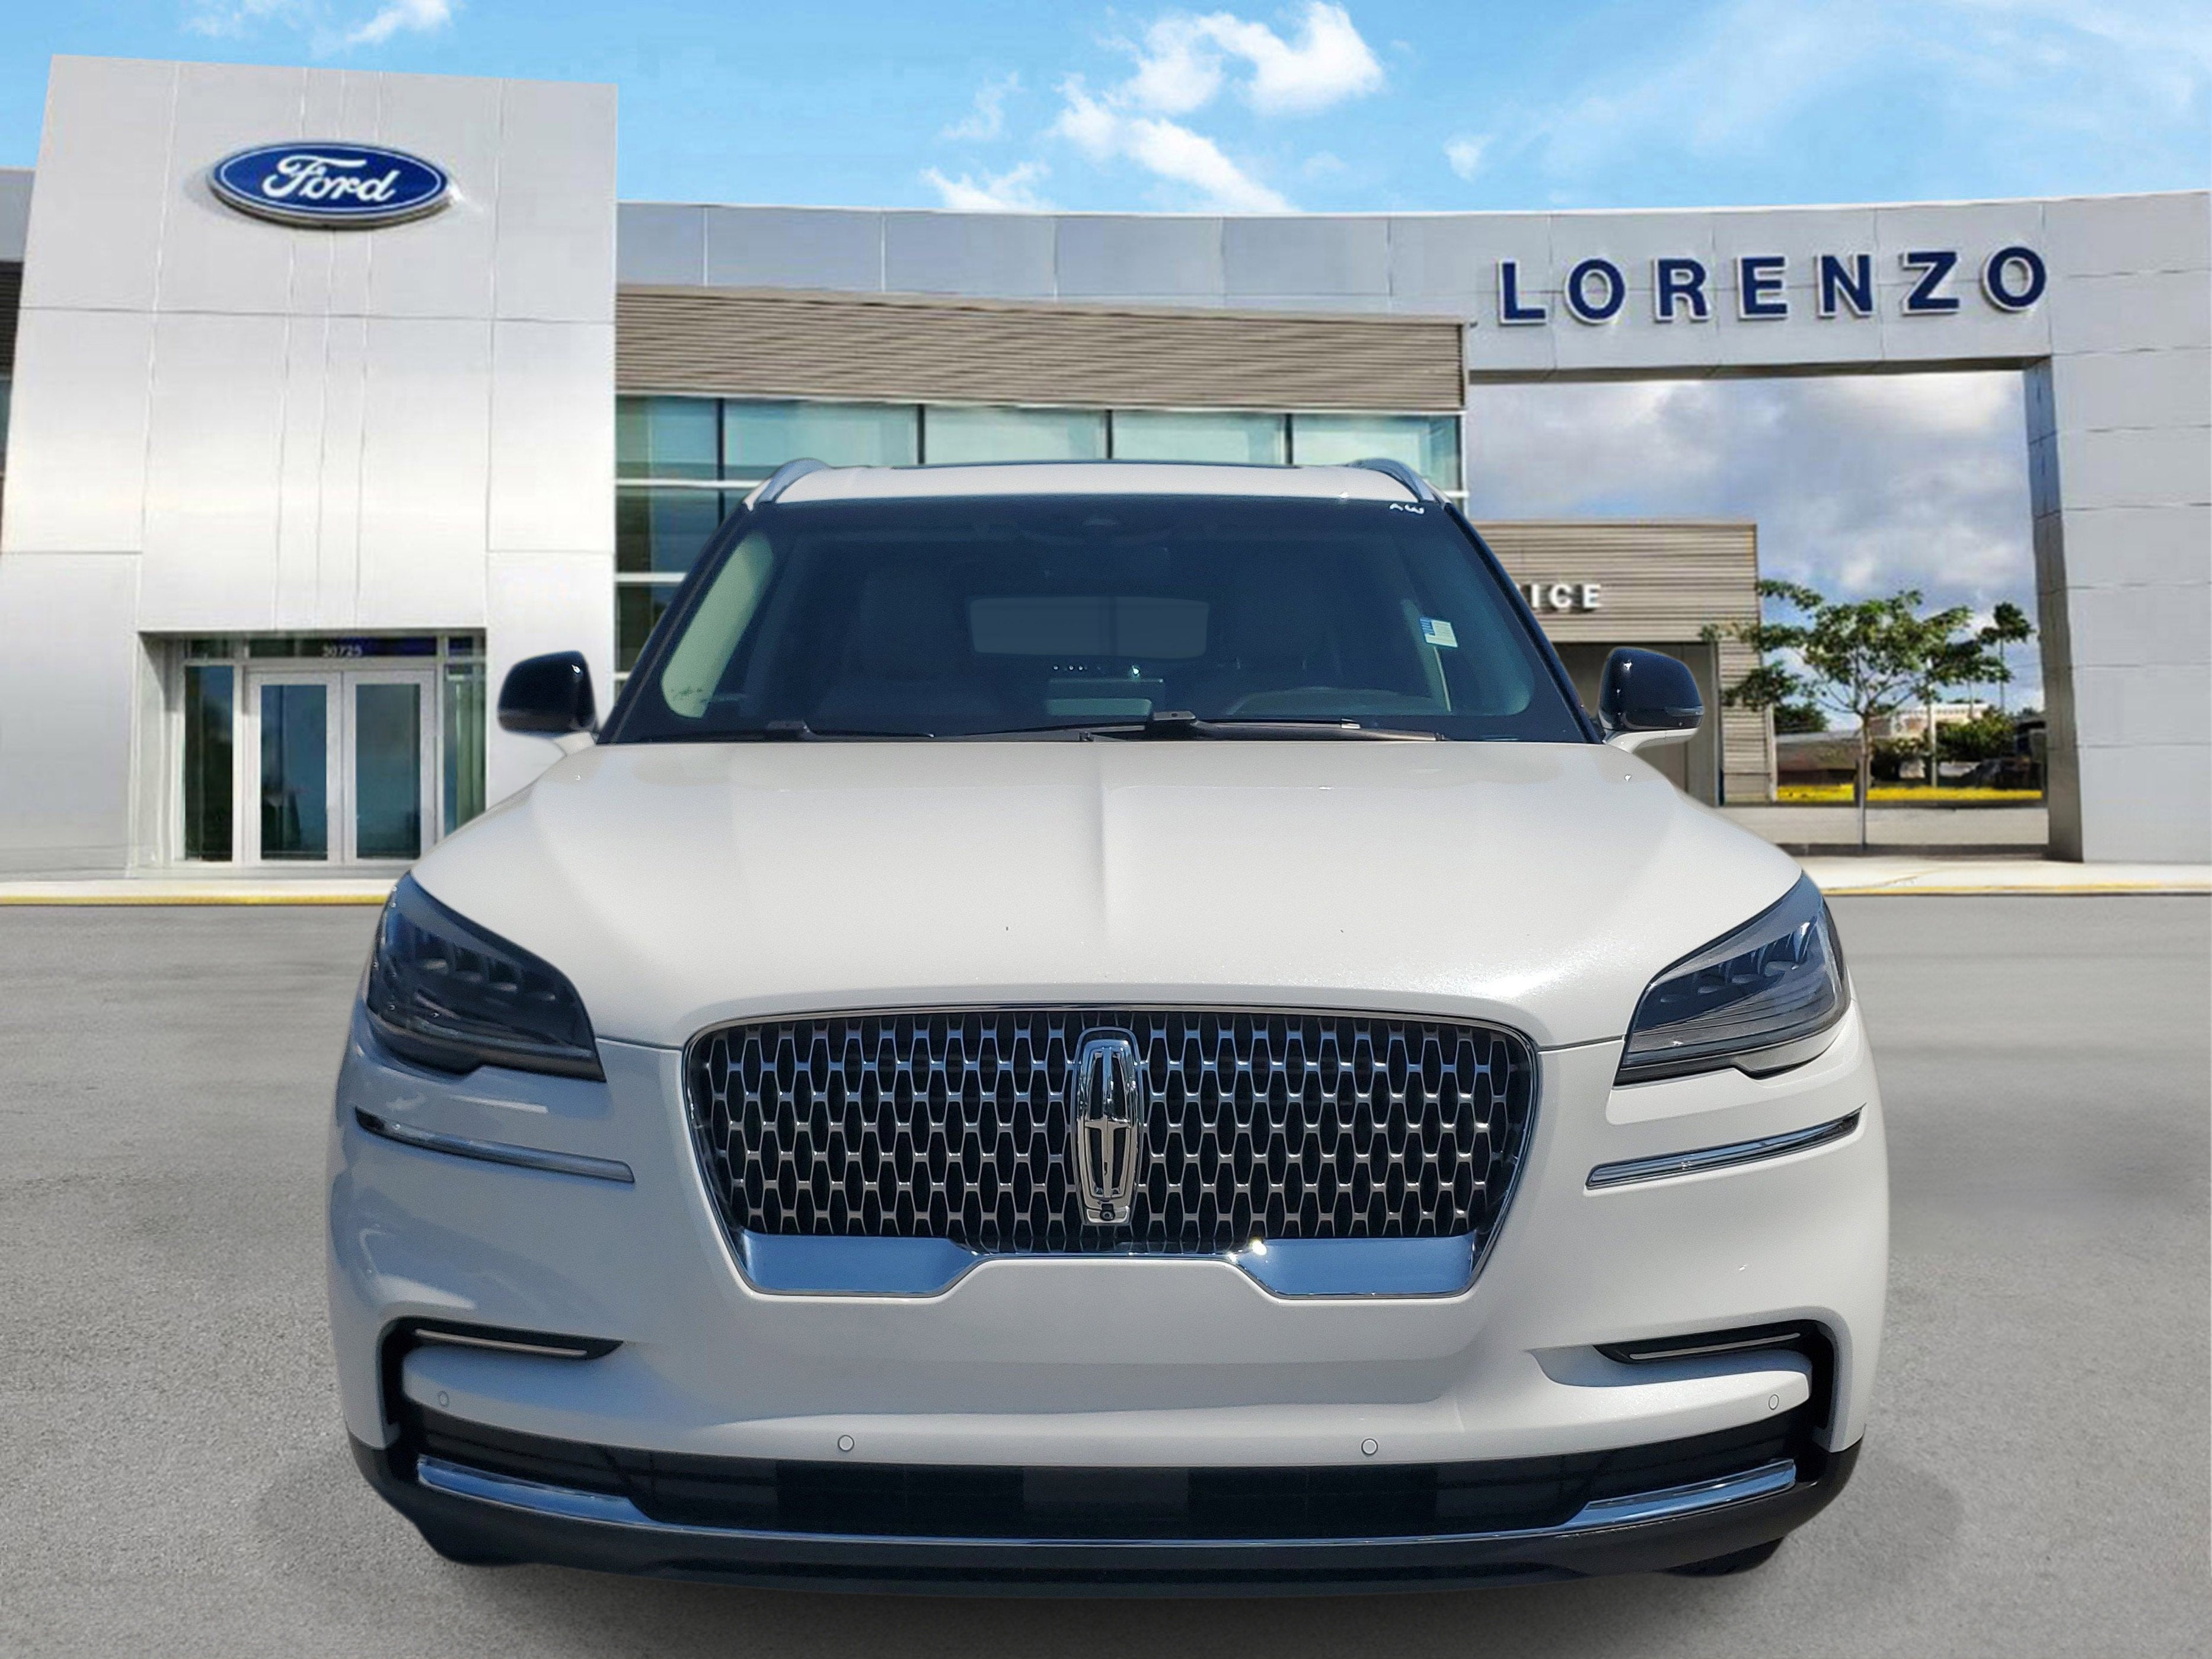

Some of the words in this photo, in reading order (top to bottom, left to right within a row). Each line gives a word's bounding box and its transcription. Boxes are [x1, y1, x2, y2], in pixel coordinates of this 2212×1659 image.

[262, 154, 400, 202] Ford
[1499, 245, 2047, 325] LORENZO
[1517, 583, 1602, 608] ICE
